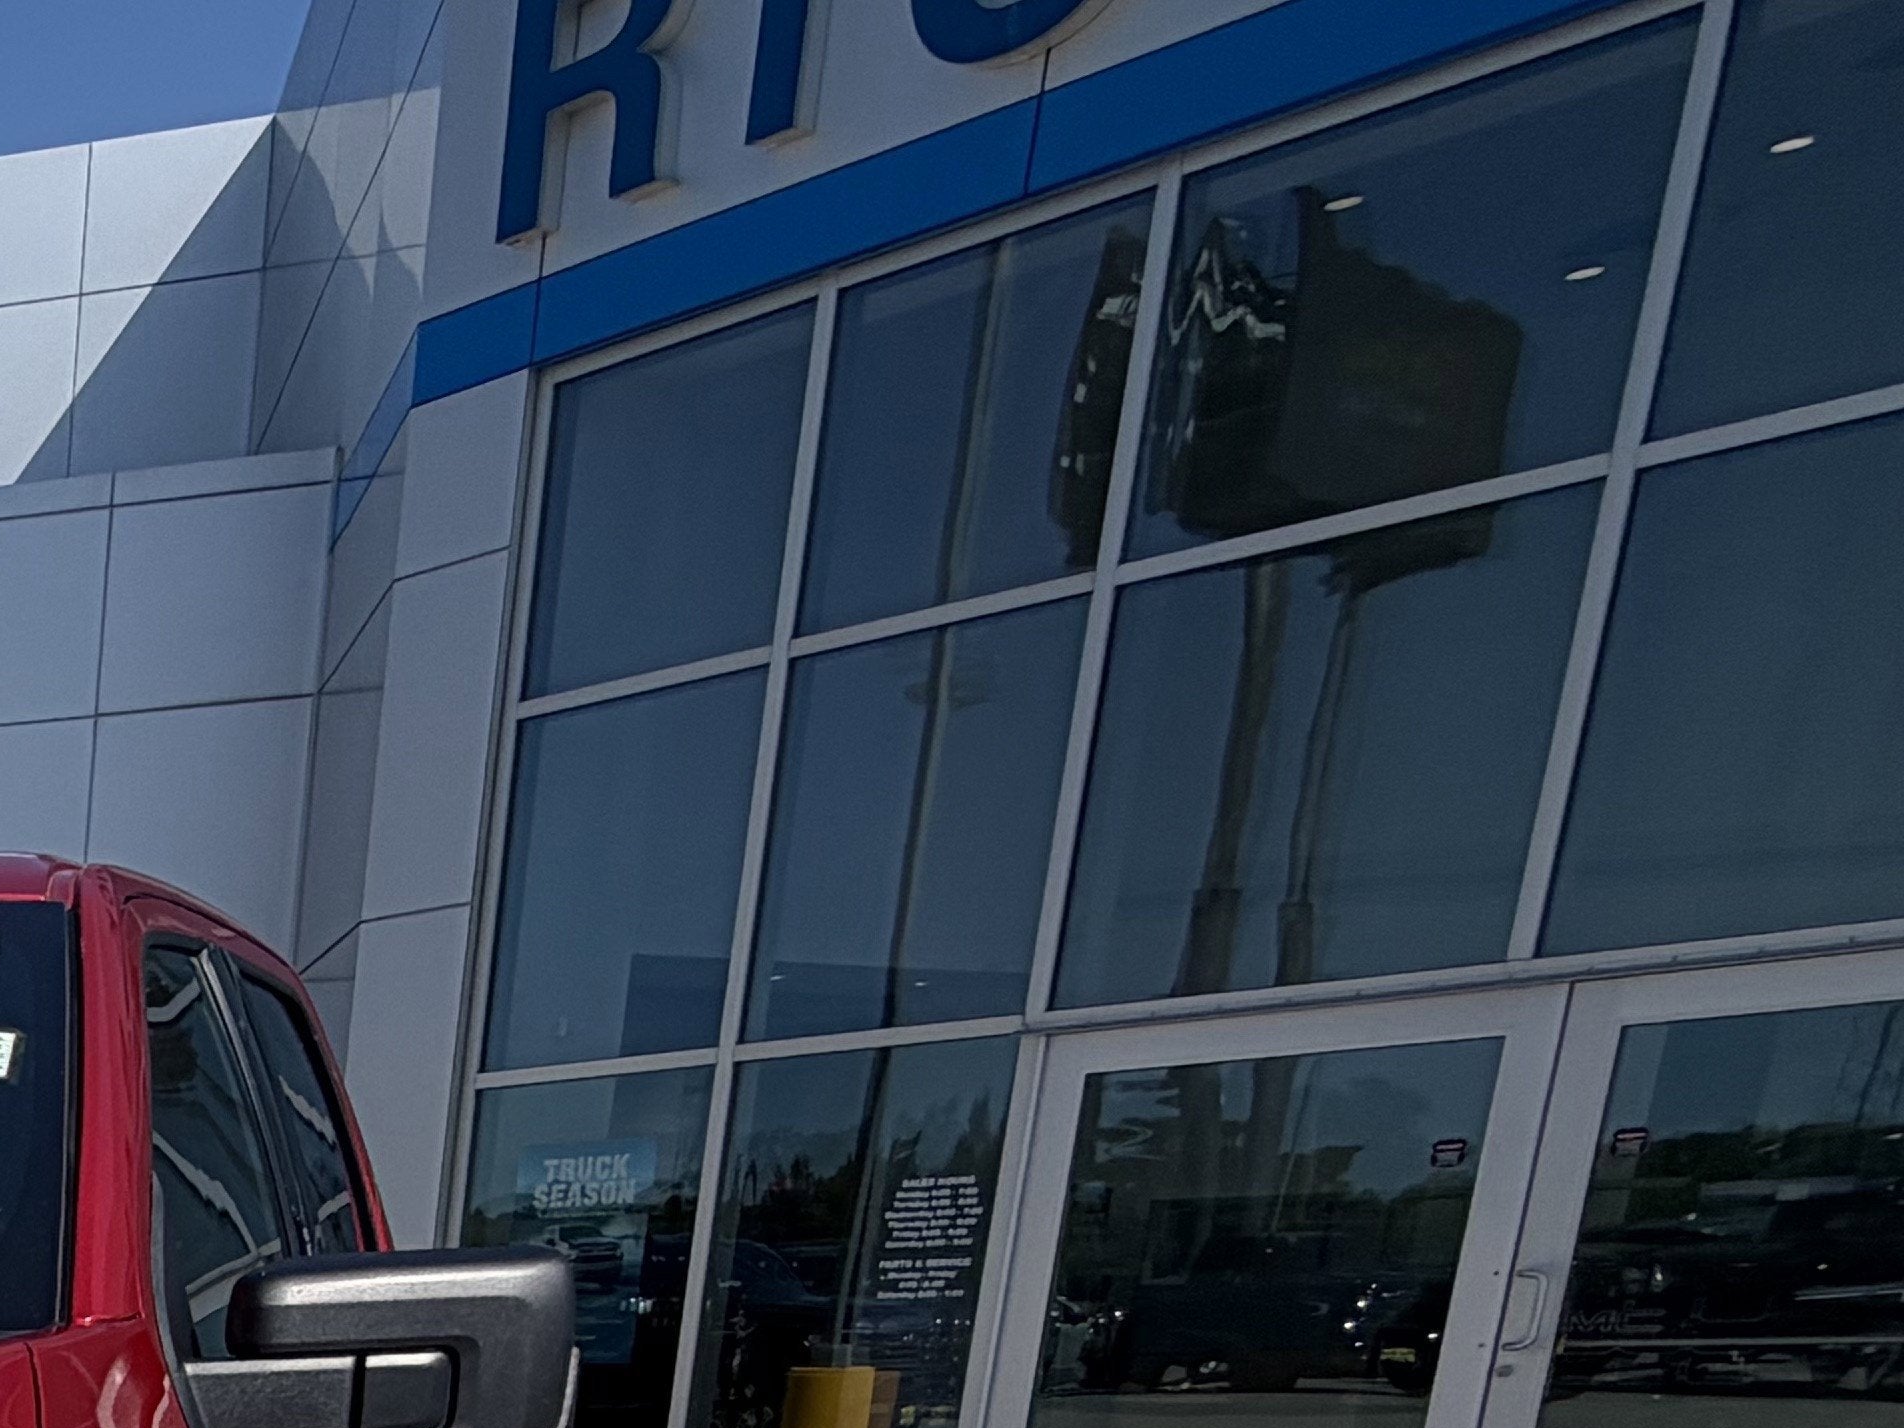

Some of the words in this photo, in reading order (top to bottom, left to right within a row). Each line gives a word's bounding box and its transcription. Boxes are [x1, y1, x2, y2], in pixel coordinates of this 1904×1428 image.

[496, 0, 1085, 244] RI
[543, 1153, 630, 1182] TRUCK
[532, 1179, 636, 1208] SEASON
